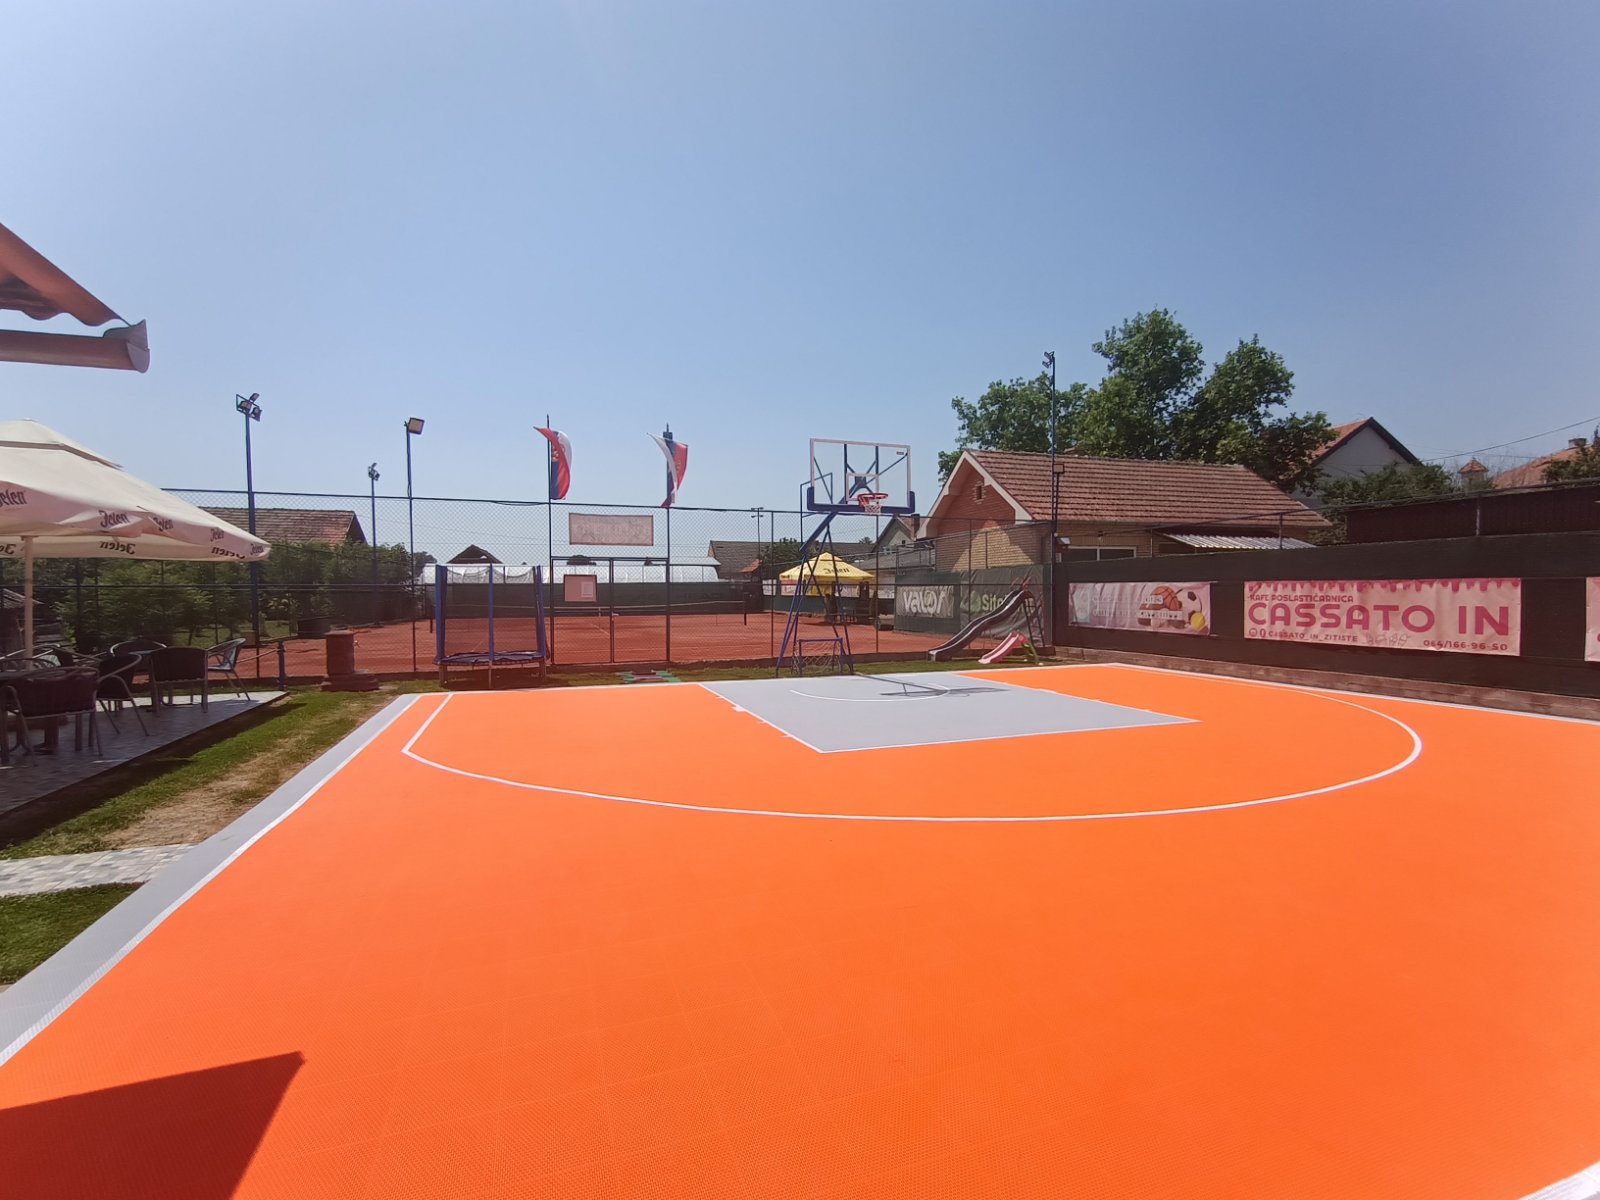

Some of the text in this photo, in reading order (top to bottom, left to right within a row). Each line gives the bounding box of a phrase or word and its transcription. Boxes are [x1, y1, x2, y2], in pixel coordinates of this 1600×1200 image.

[98, 510, 130, 528] Jelen
[1271, 593, 1354, 603] POSLASTIČARNICA
[1248, 602, 1509, 636] CASSATO IN
